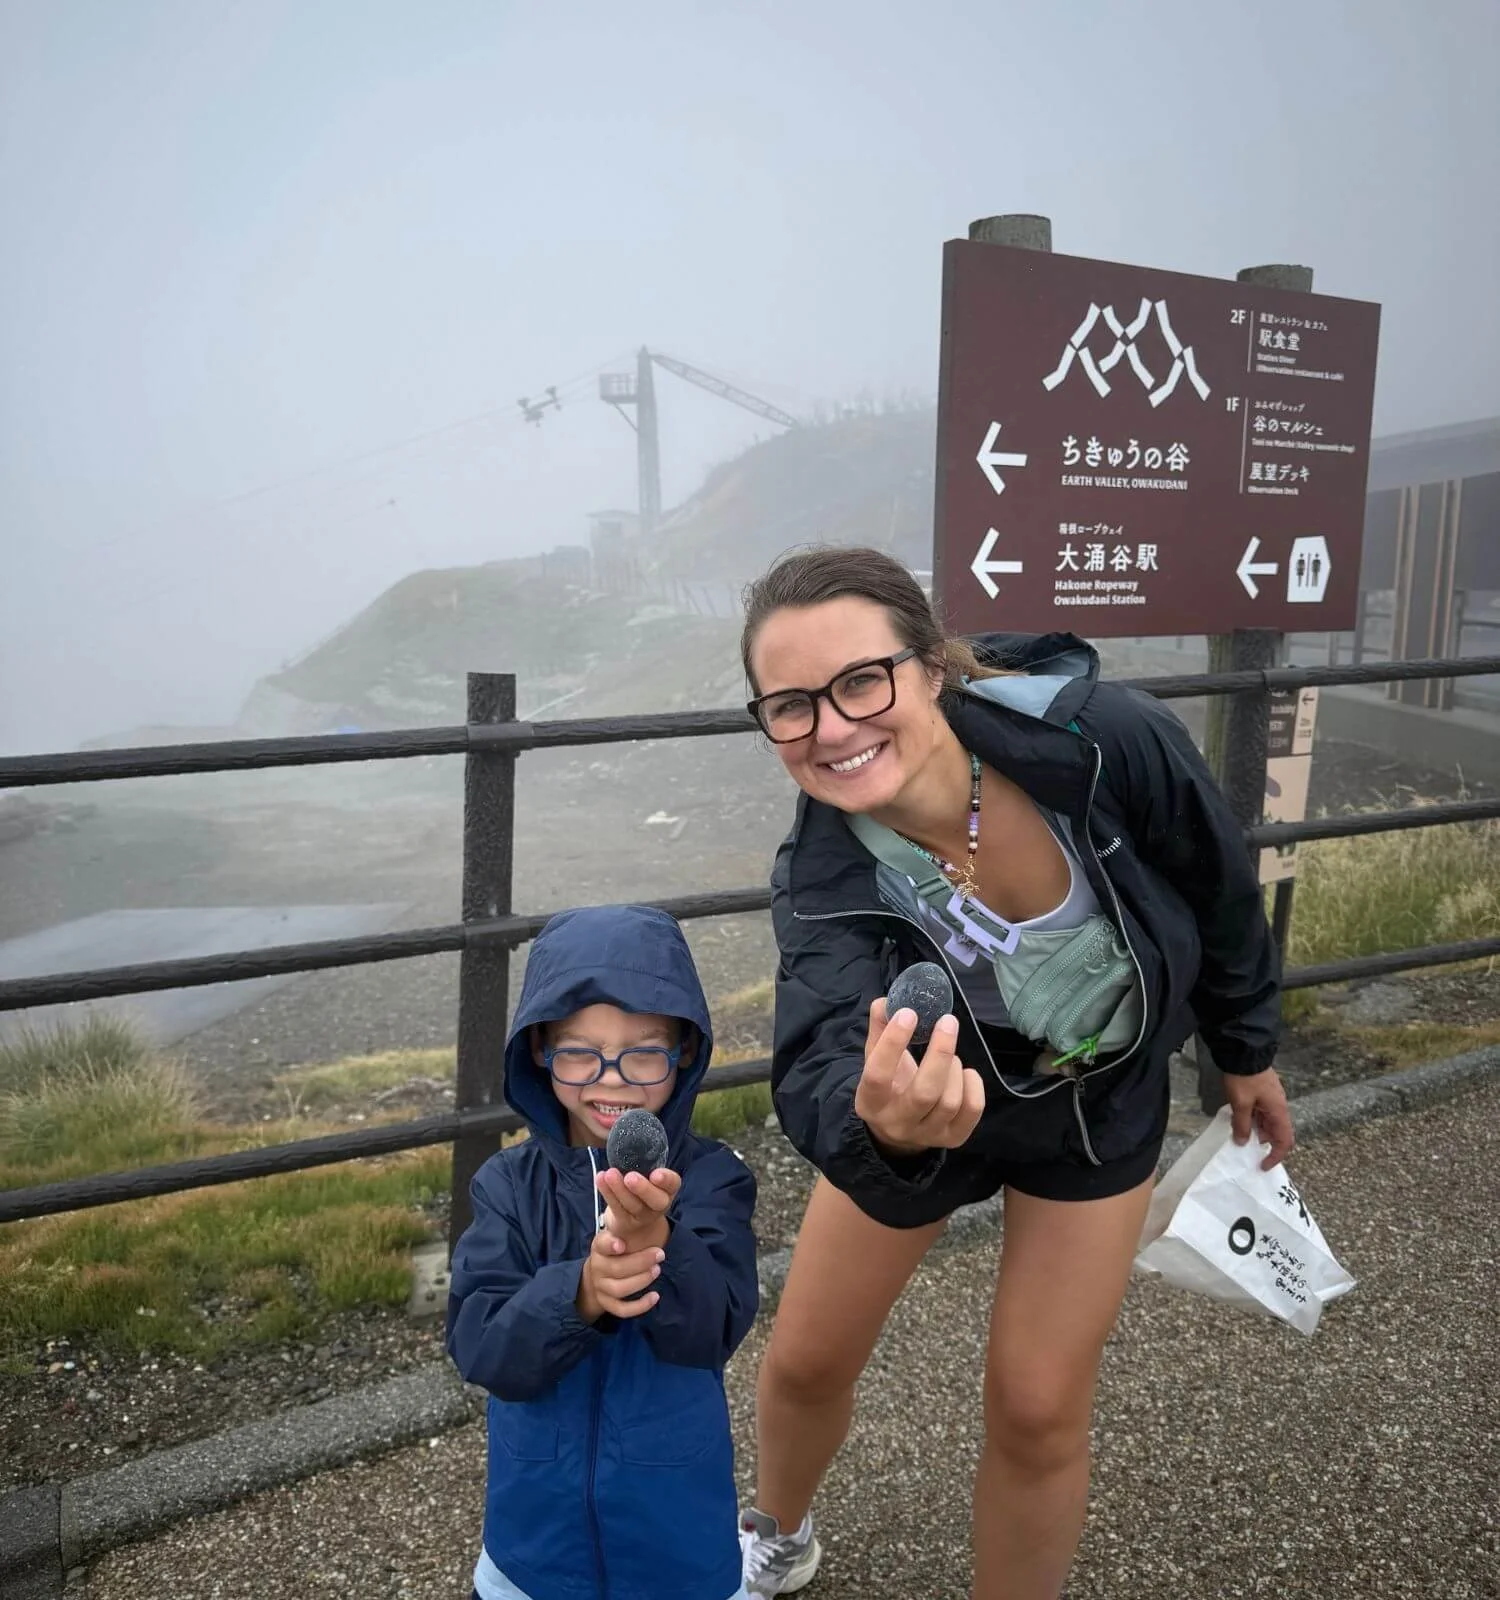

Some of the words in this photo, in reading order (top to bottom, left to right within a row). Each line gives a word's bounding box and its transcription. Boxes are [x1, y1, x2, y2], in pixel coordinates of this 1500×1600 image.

[1230, 308, 1246, 325] 2F
[1258, 328, 1301, 351] 駅食堂
[1226, 396, 1240, 412] 1F
[1251, 414, 1324, 436] 谷のマルシェ
[1061, 434, 1191, 472] ちきゅうの谷
[1248, 461, 1311, 483] 展望デッキ
[1061, 474, 1093, 487] EARTH
[1094, 476, 1130, 489] VALLEY,
[1131, 478, 1188, 491] OWAKUDANI
[1058, 522, 1124, 535] 箱根ロープウェイ
[1055, 542, 1159, 572] 大涌谷駅
[1054, 580, 1093, 591] Hakone
[1093, 580, 1139, 593] Ropeway
[1053, 593, 1110, 606] Owakudani
[1111, 593, 1147, 605] Station
